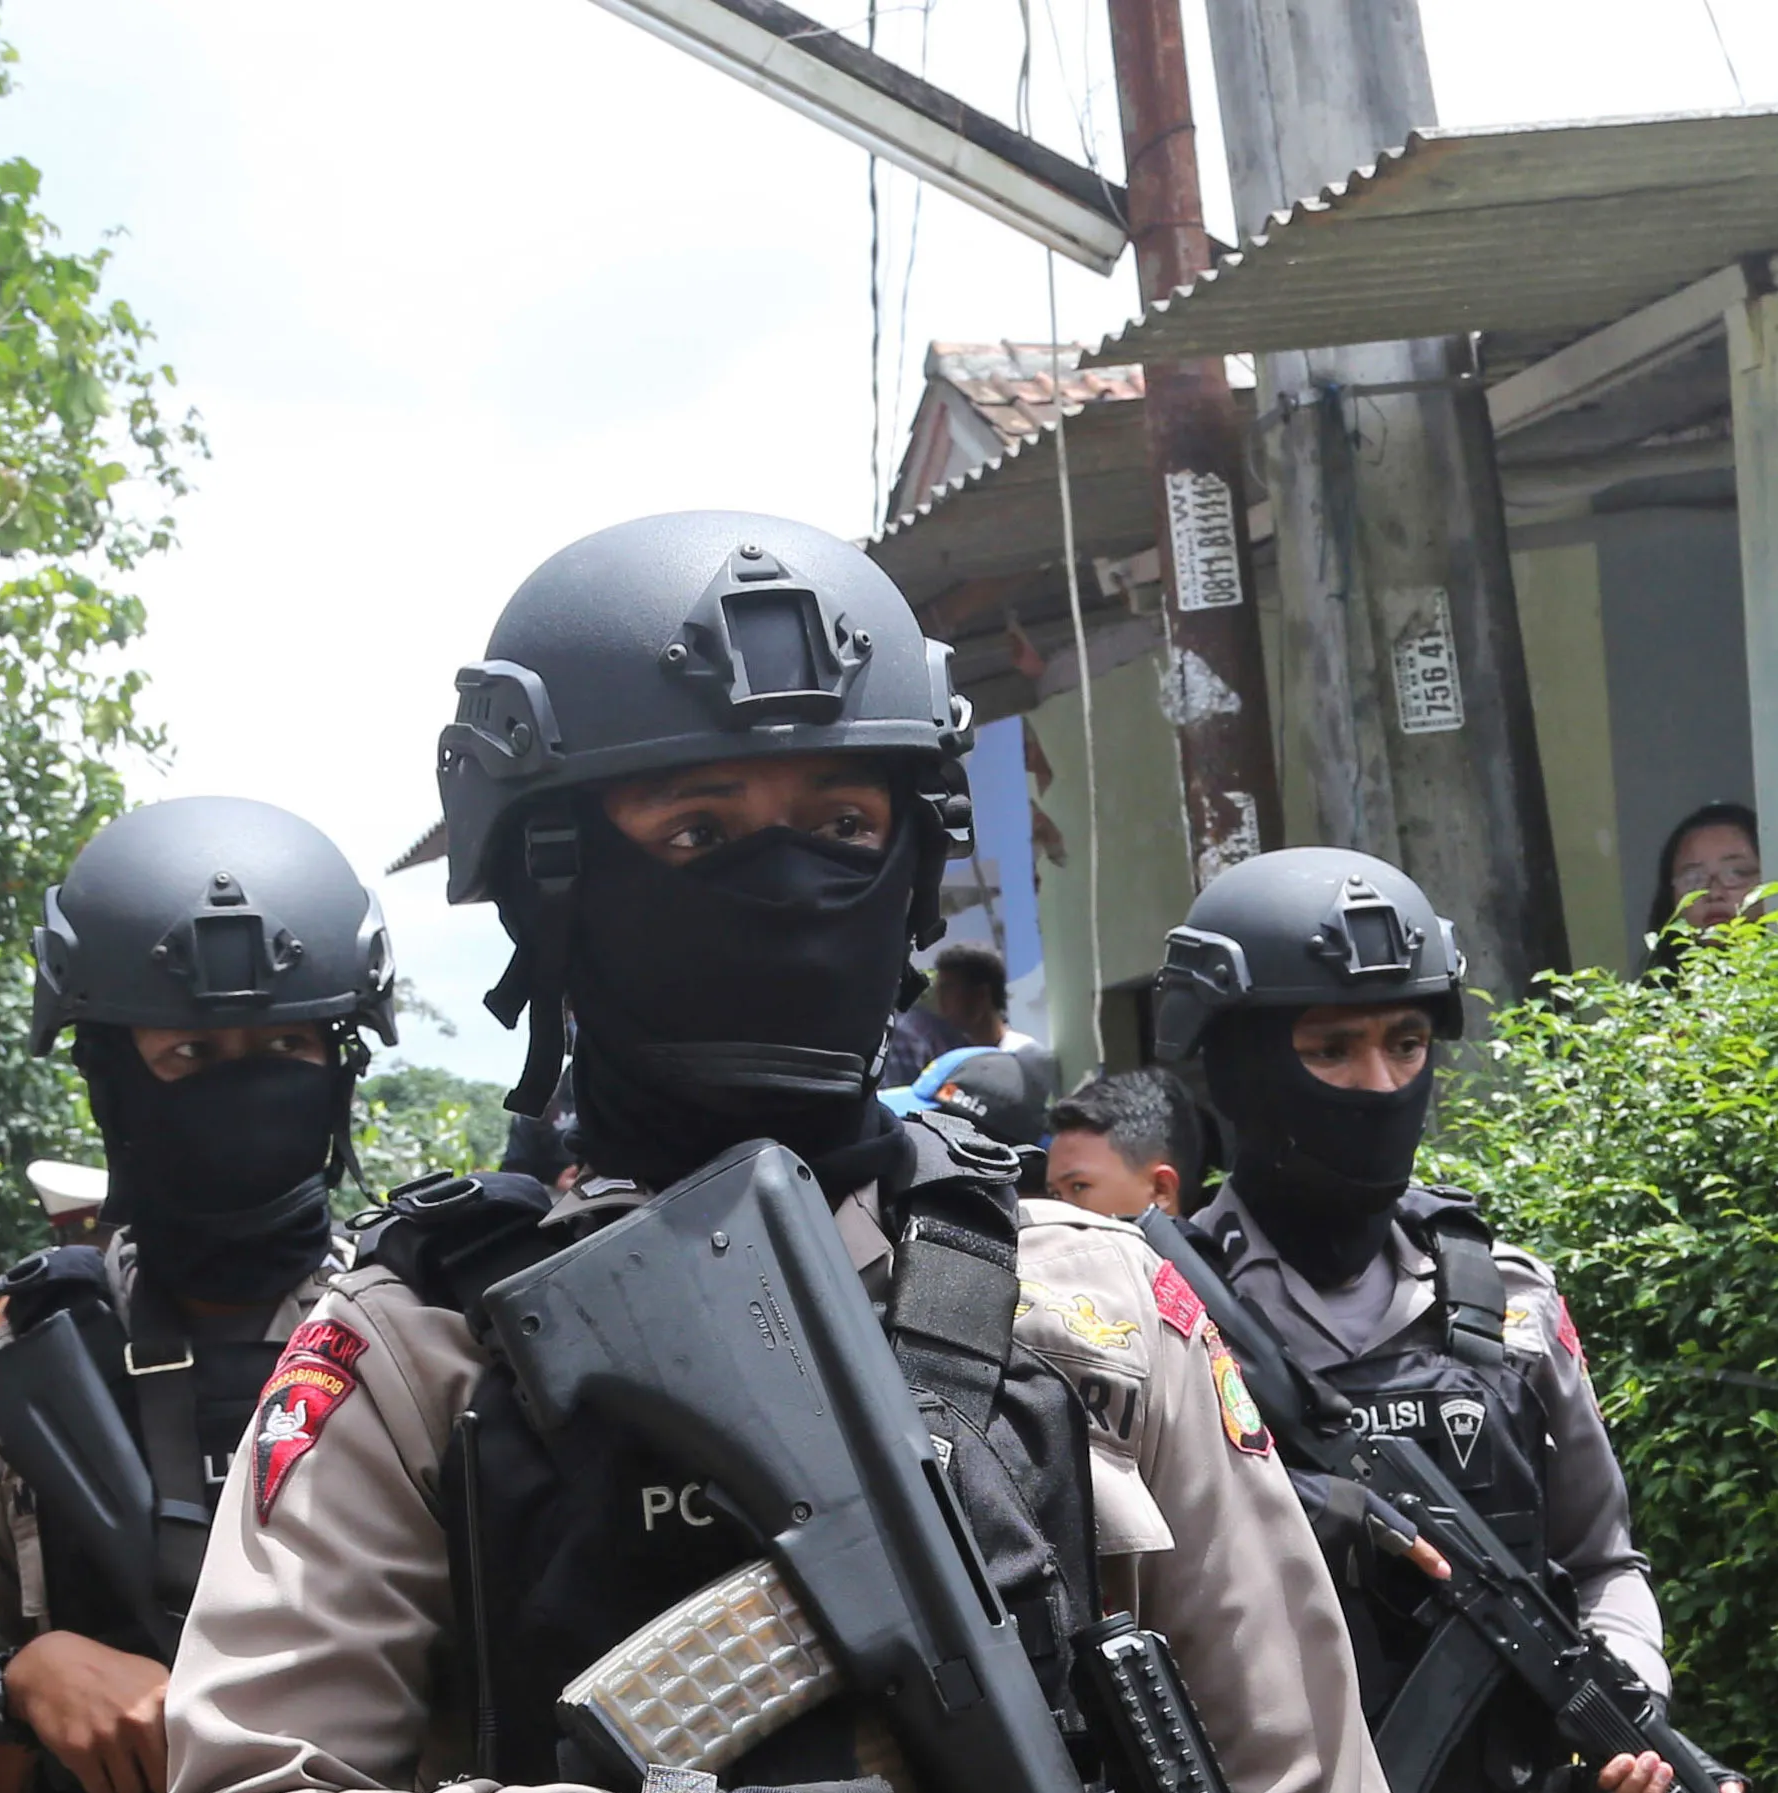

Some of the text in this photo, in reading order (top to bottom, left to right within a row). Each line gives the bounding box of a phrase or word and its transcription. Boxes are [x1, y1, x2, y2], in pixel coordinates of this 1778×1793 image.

[1199, 555, 1238, 604] 0811
[1421, 666, 1452, 716] 756
[1351, 1400, 1426, 1435] OLISI
